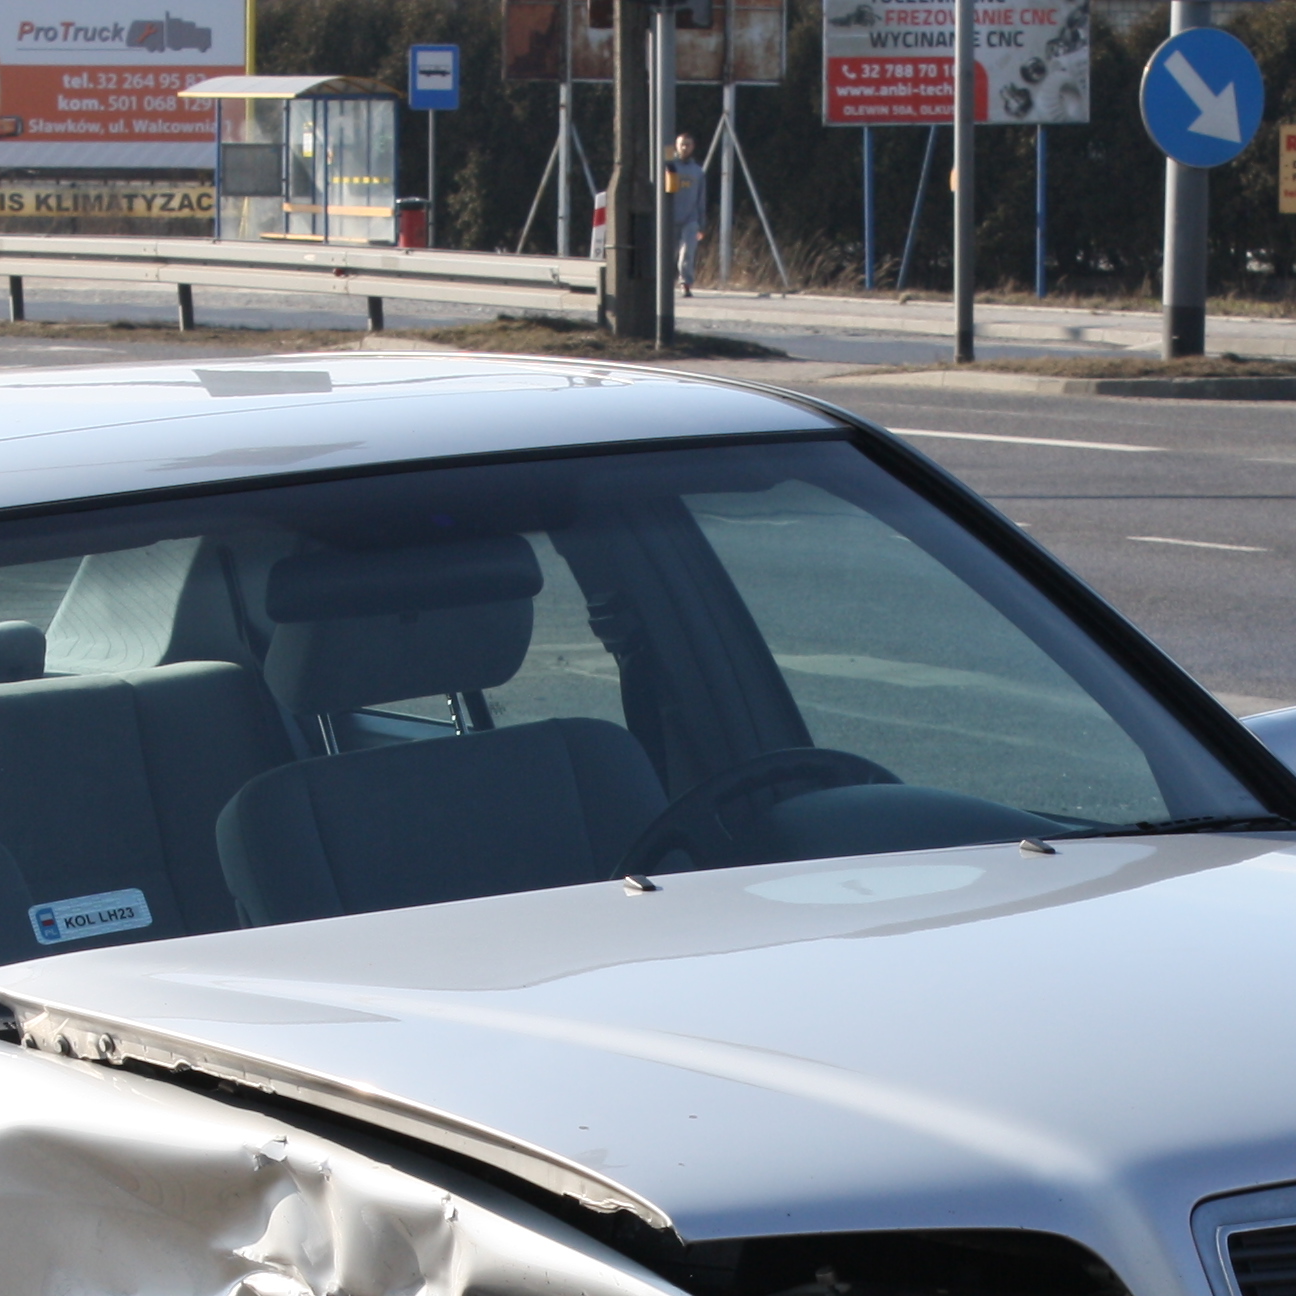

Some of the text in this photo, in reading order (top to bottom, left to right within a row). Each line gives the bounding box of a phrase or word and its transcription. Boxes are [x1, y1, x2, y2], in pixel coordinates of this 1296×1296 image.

[1020, 9, 1058, 25] CNC
[18, 21, 127, 43] ProTruck
[987, 30, 1024, 47] CNC
[861, 65, 880, 78] 32
[62, 73, 94, 88] tel.
[97, 74, 119, 88] 32
[123, 74, 154, 88] 264
[160, 74, 181, 88] 95
[58, 95, 105, 111] kom.
[108, 96, 137, 110] 501
[144, 96, 176, 110] 068
[29, 118, 104, 136] Sławków,
[109, 119, 128, 134] ul.
[64, 907, 135, 929] KOL LH23
